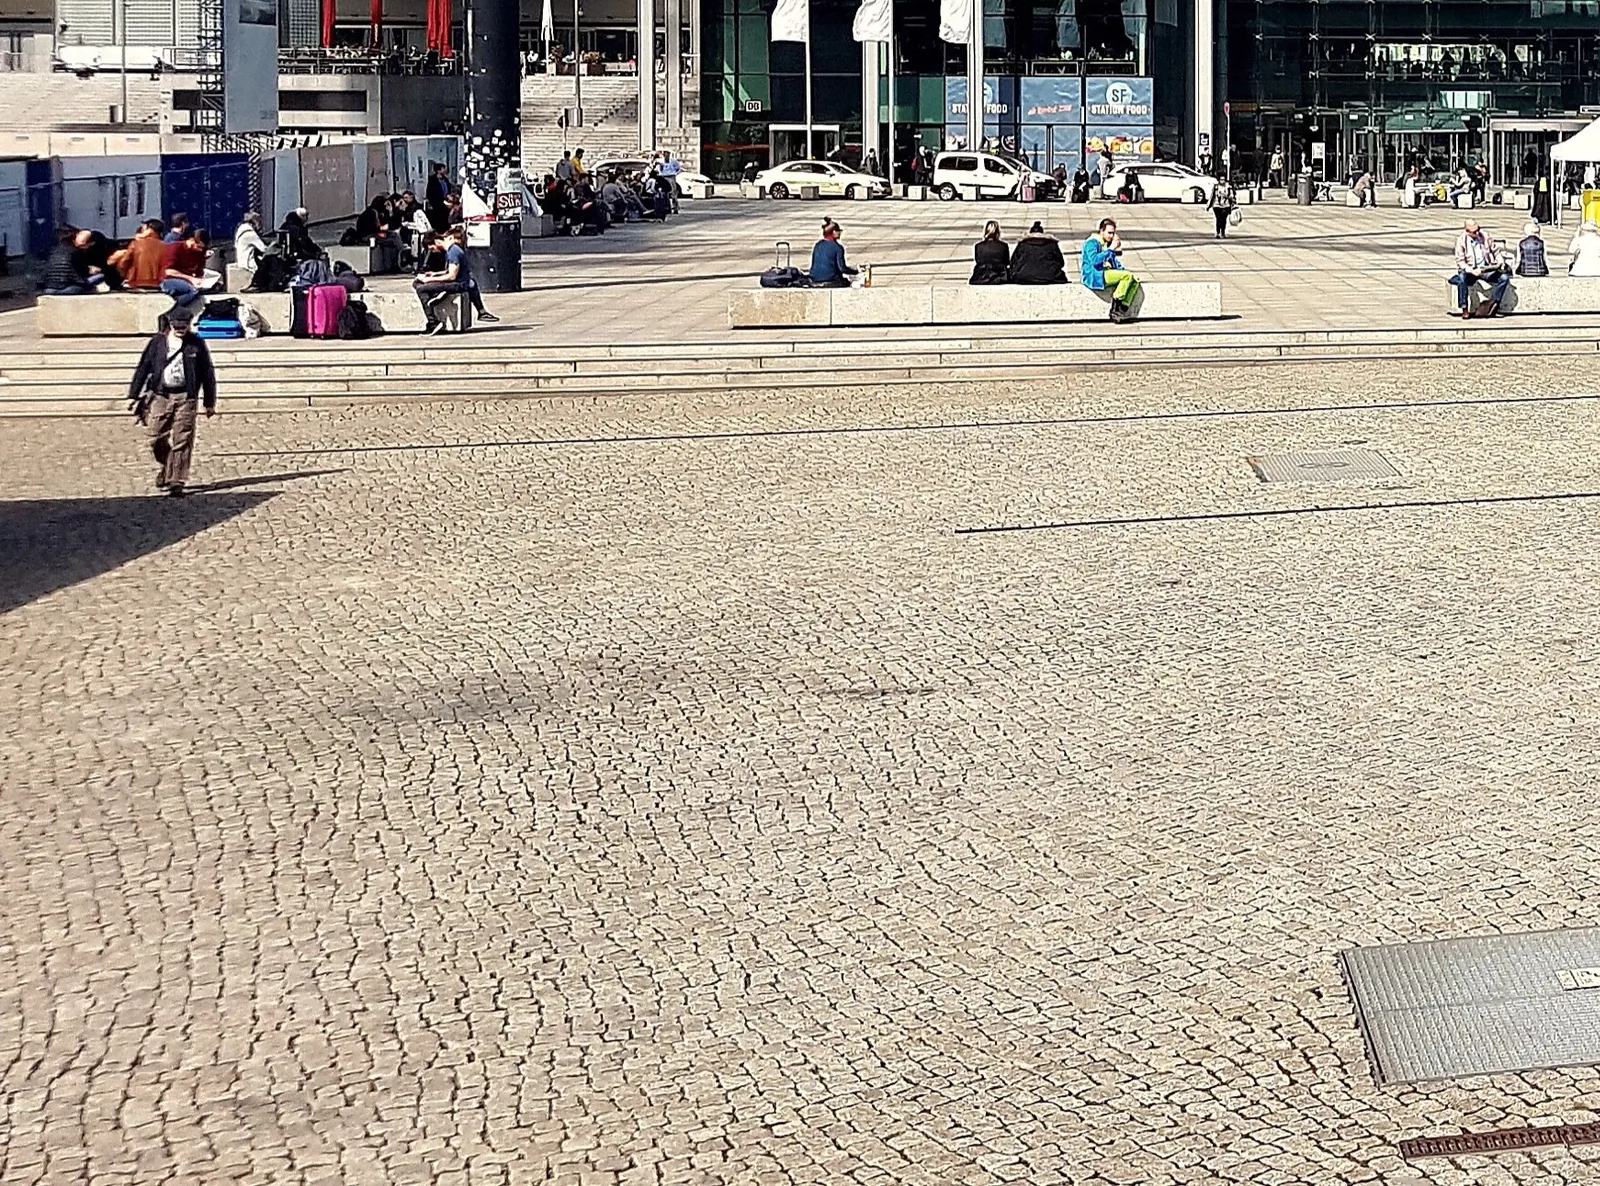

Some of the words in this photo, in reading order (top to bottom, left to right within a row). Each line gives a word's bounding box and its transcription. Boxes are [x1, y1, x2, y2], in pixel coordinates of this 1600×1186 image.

[1111, 88, 1128, 103] SF
[1090, 104, 1125, 115] STATION
[1126, 104, 1148, 115] FOOD
